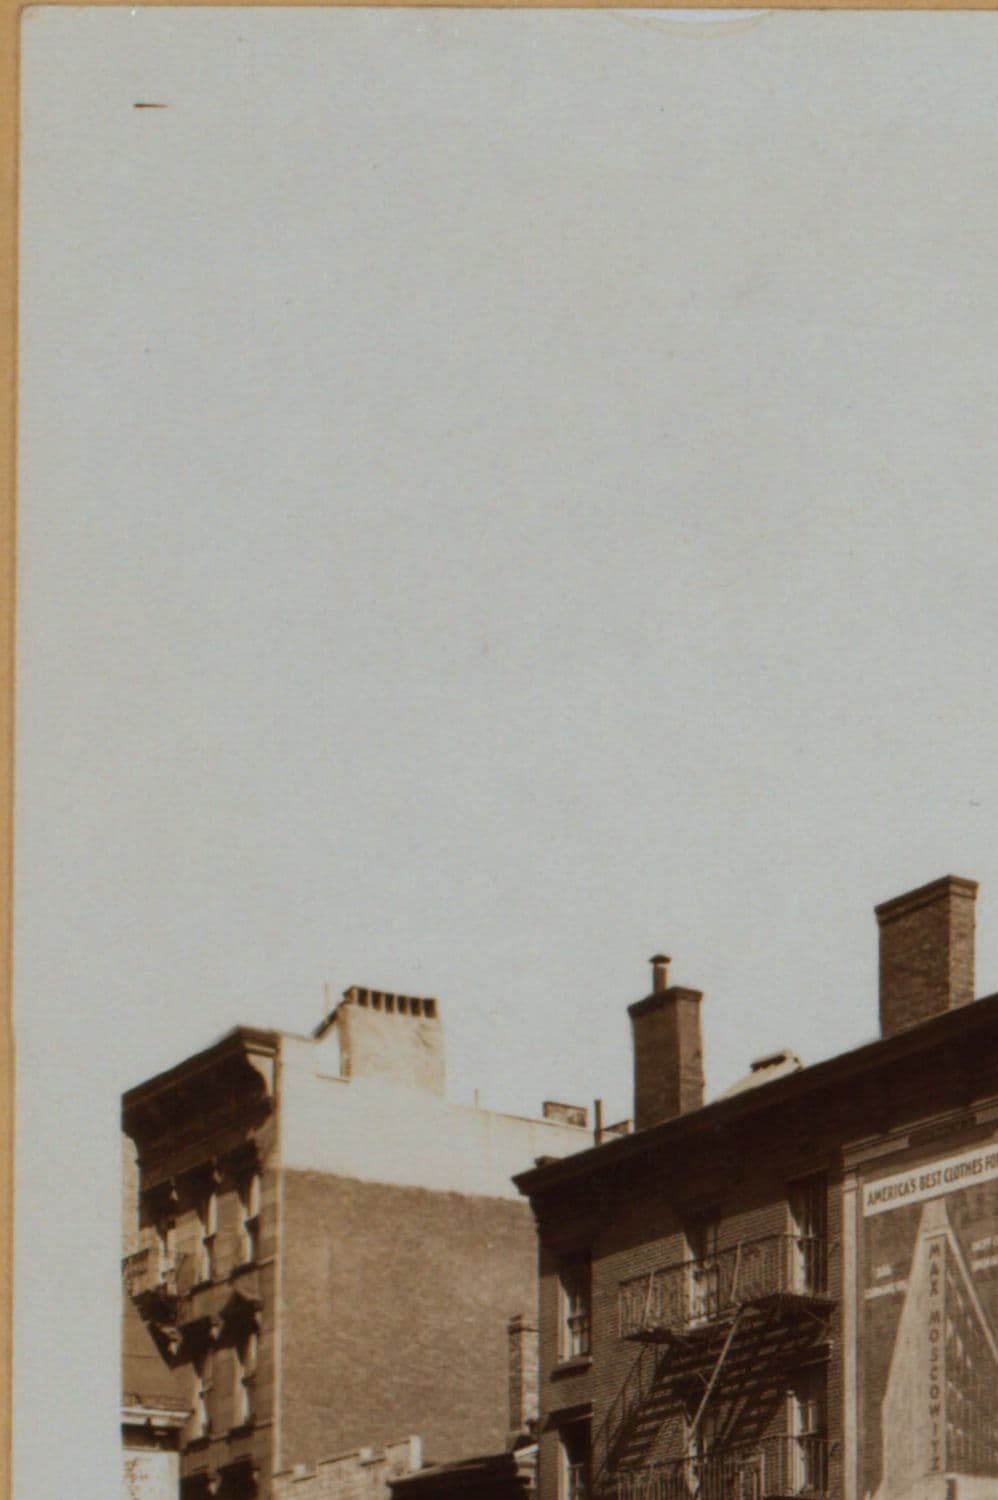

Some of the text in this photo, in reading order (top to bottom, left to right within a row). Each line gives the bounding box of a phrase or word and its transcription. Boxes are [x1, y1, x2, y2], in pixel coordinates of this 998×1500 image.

[866, 1177, 917, 1206] AMERICA'S
[919, 1170, 942, 1191] BEST
[943, 1159, 983, 1185] CLOTHES
[928, 1244, 941, 1472] MAX MOSCOWITZ
